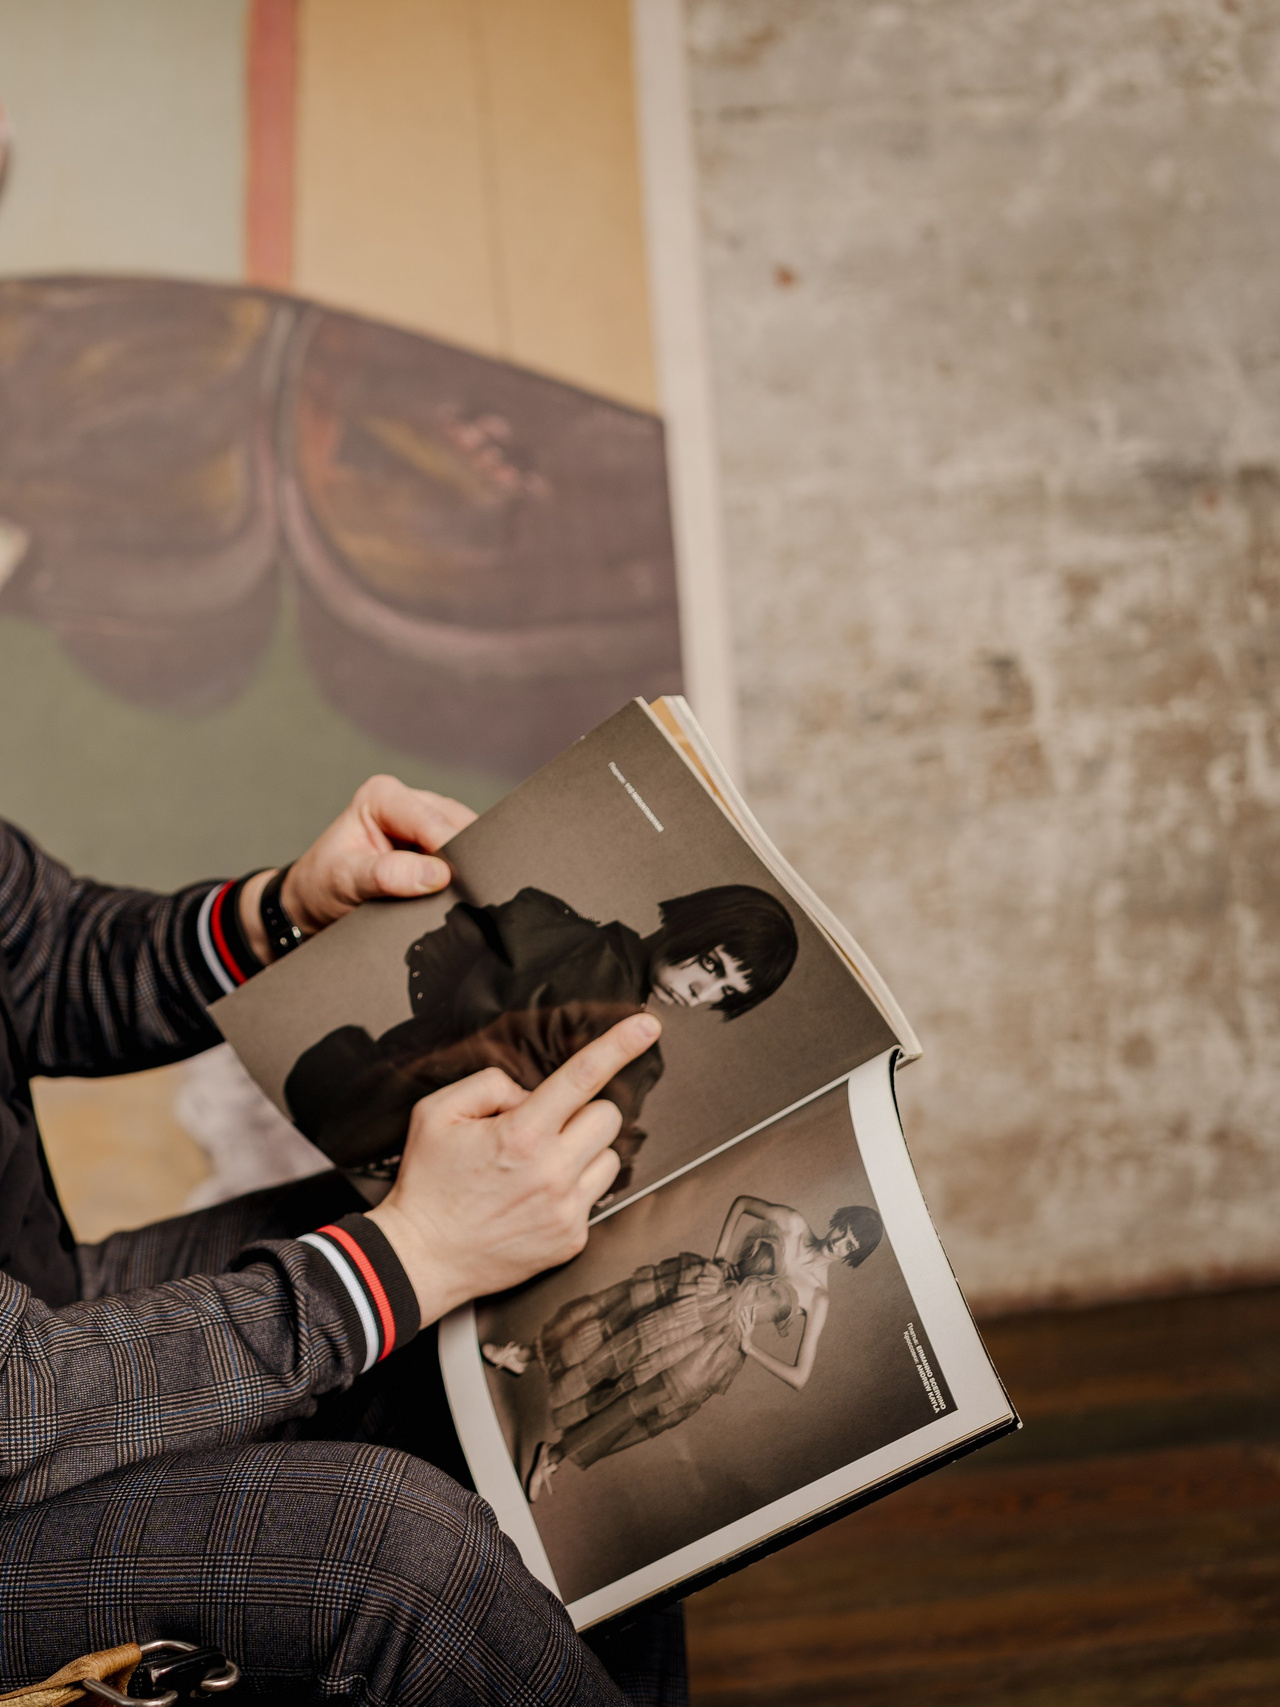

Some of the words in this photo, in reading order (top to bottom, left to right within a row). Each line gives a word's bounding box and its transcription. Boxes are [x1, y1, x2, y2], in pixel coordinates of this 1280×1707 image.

[916, 1345, 933, 1377] ERMANNO
[916, 1364, 932, 1392] ANDREW
[928, 1392, 940, 1413] KAYLA
